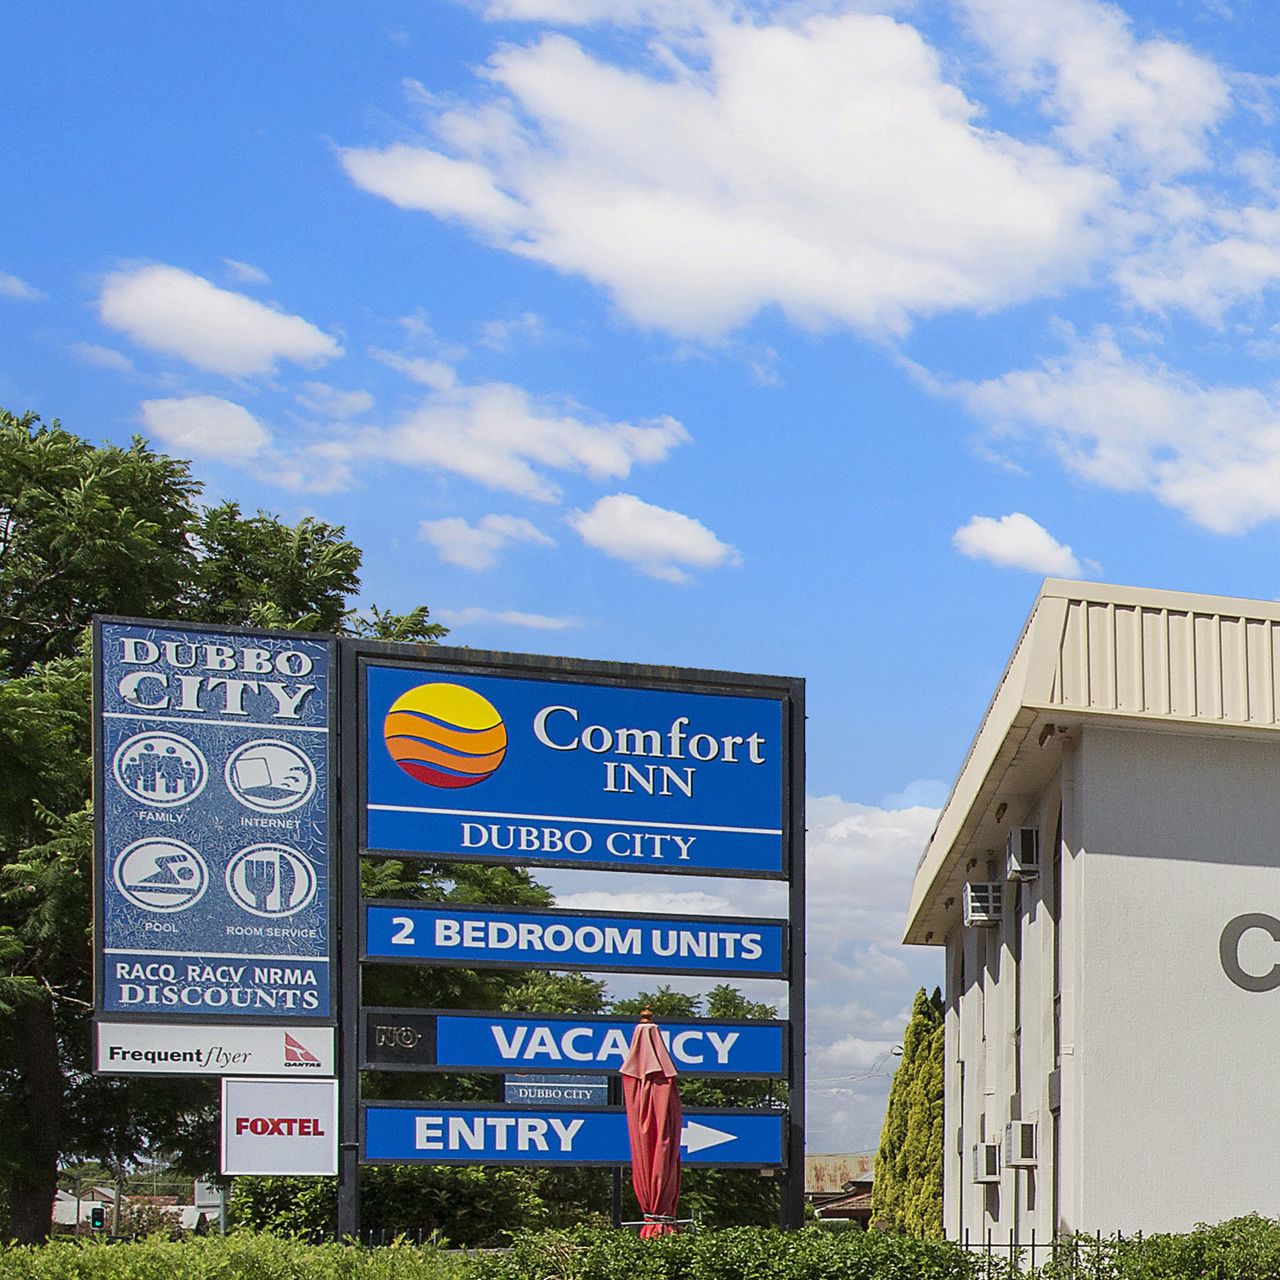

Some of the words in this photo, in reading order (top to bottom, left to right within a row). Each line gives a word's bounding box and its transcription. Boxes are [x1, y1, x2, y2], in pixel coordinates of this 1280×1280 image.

[119, 638, 314, 677] DUBBO
[119, 671, 316, 720] CITY
[533, 705, 765, 763] Comfort
[602, 762, 697, 798] INN
[138, 811, 185, 823] FAMILY
[240, 817, 301, 829] INTERNET
[460, 822, 592, 855] DUBBO
[606, 832, 697, 861] CITY
[145, 922, 179, 933] POOL
[226, 926, 263, 936] ROOM
[266, 928, 317, 939] SERVICE
[391, 917, 415, 945] 2
[435, 919, 642, 955] BEDROOM
[651, 930, 762, 960] UNITS
[116, 964, 175, 981] RACQ
[188, 966, 243, 983] RACV
[254, 967, 317, 985] NRMA
[118, 984, 319, 1009] DISCOUNTS
[491, 1025, 740, 1064] VACACY
[519, 1089, 561, 1098] DUBBO
[564, 1090, 592, 1099] CITY
[236, 1117, 325, 1136] FOXTEL
[415, 1117, 585, 1152] ENTRY
